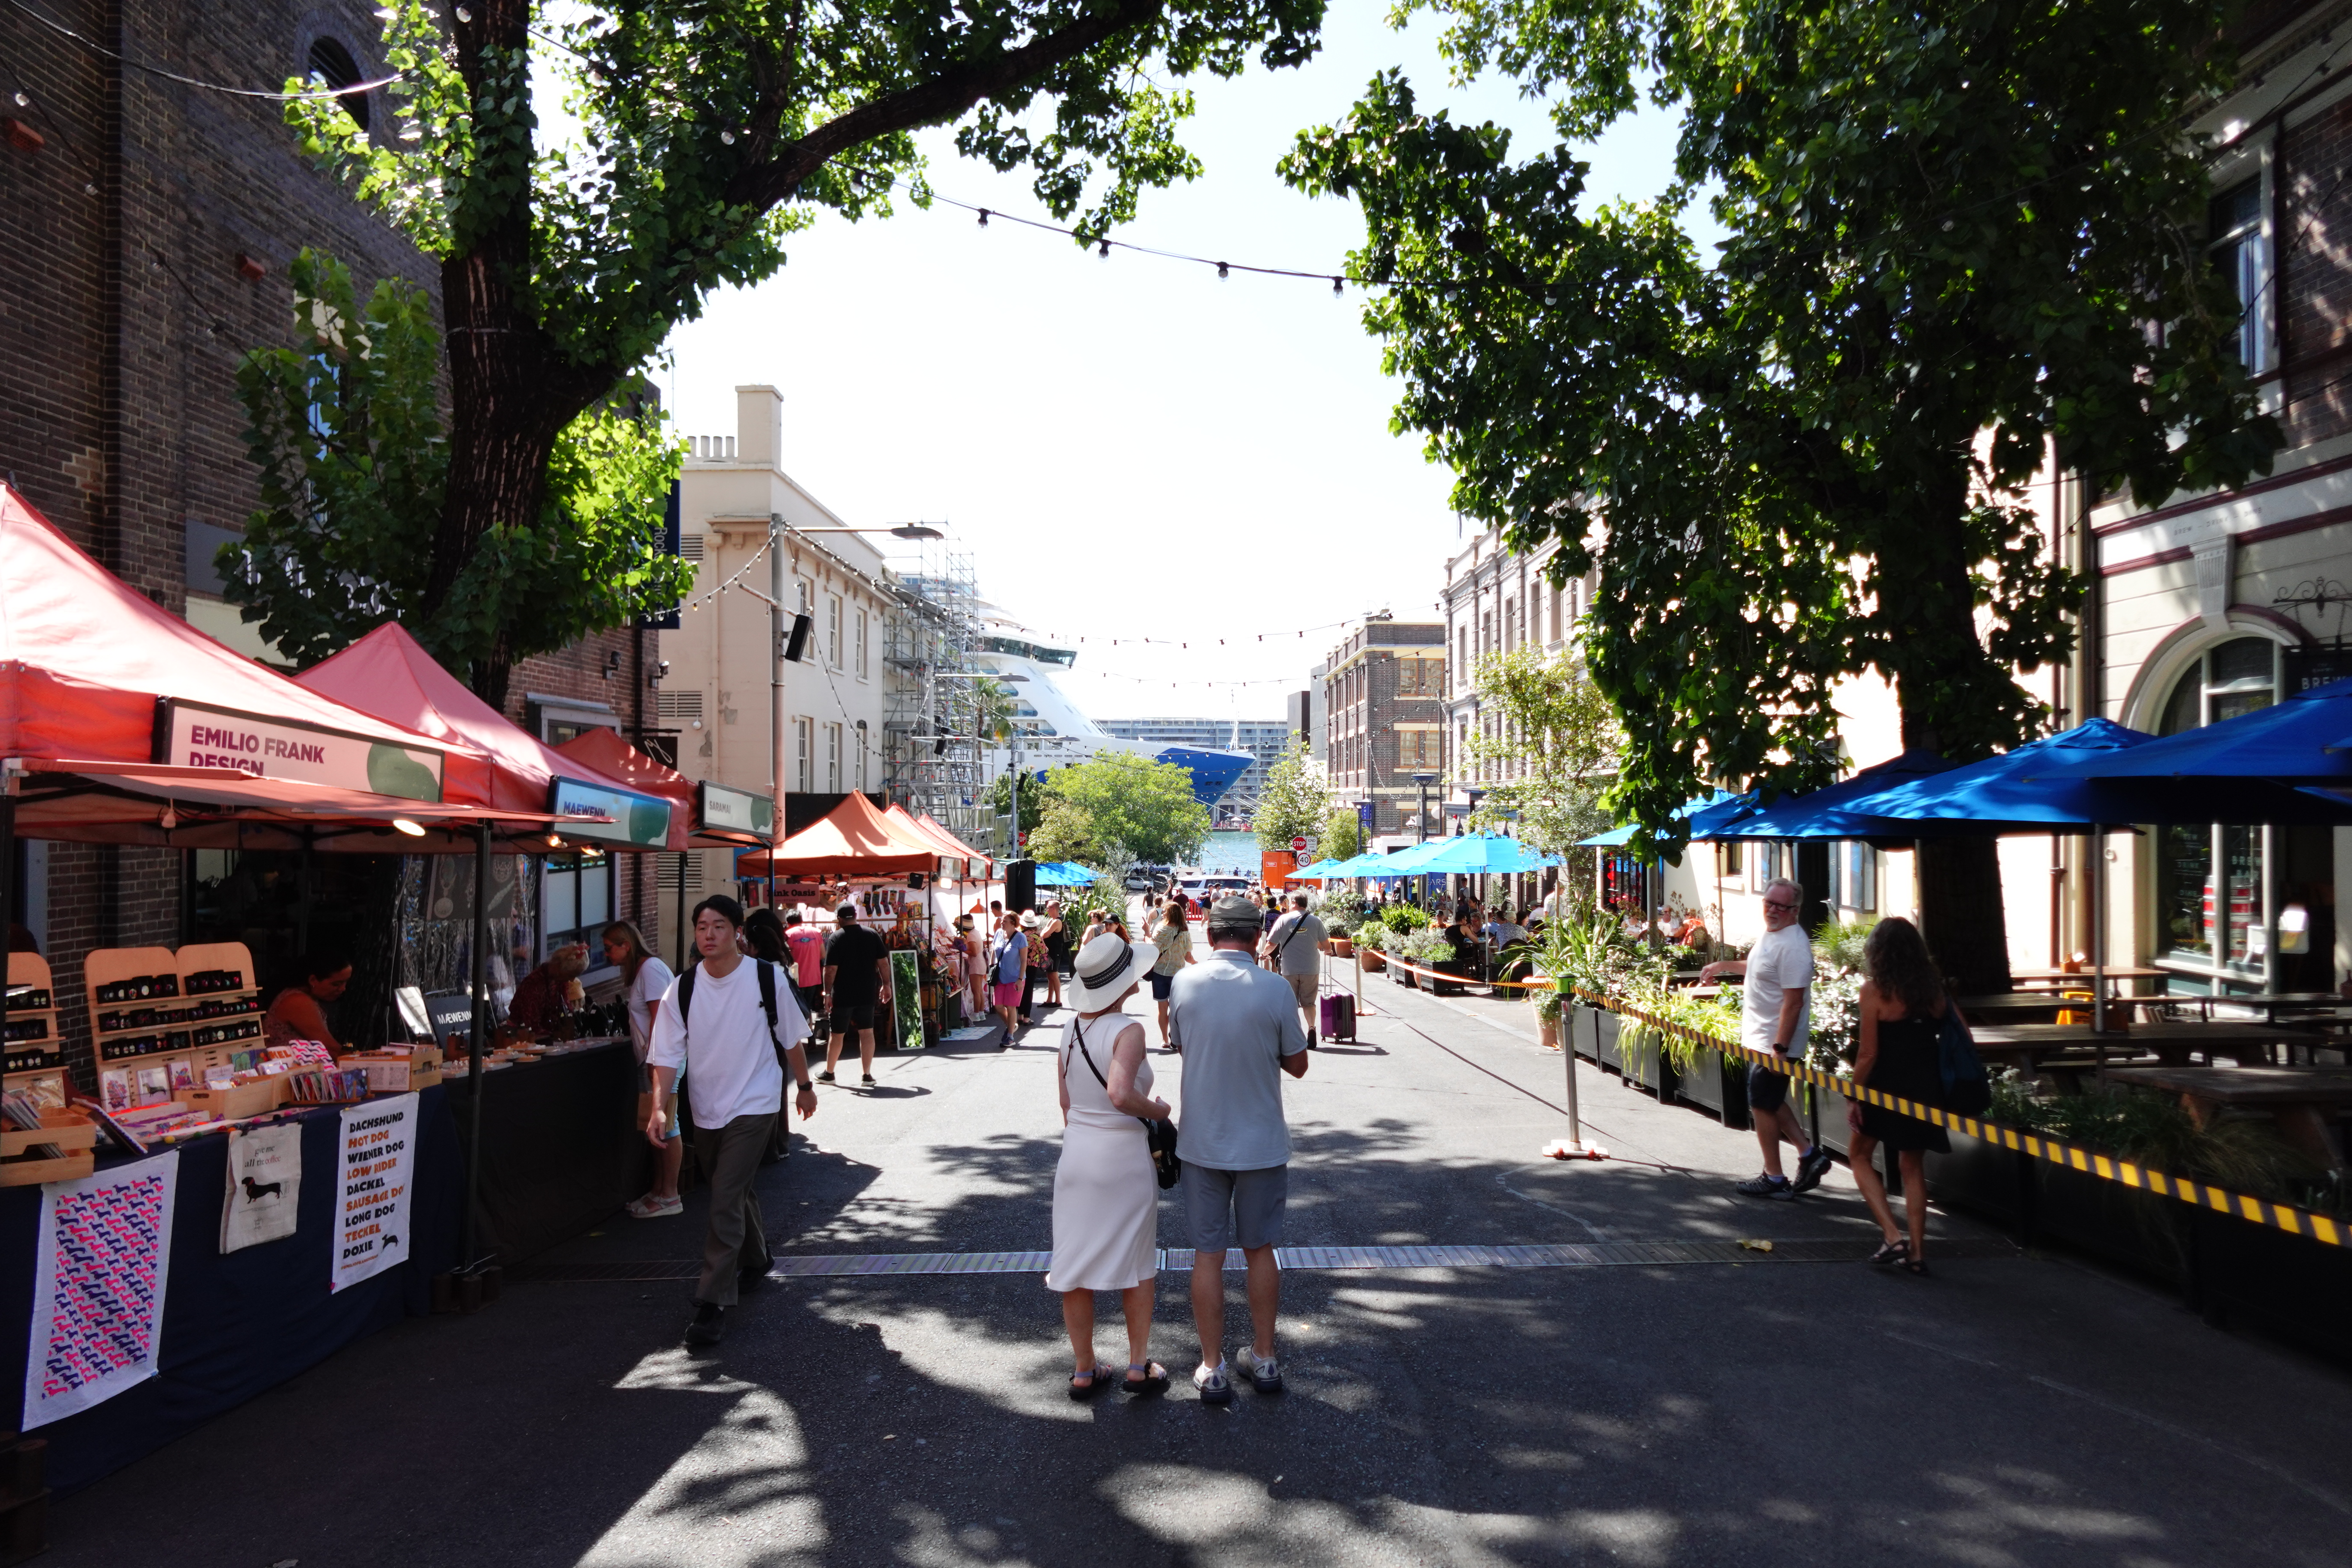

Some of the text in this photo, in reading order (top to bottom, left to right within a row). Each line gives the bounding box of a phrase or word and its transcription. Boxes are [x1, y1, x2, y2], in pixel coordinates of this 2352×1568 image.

[191, 725, 325, 764] EMILIO FRANK
[190, 751, 264, 776] DESIGN
[563, 801, 605, 817] MAEWENN
[709, 800, 731, 814] SARAMAI
[349, 1112, 404, 1133] DACHSHUND
[348, 1130, 389, 1149] HOT DOG
[245, 1159, 255, 1167] all
[265, 1155, 281, 1164] coffee
[254, 1148, 265, 1157] give
[348, 1140, 404, 1164] WIENER DOG
[347, 1158, 397, 1181] LOW RIDER
[347, 1177, 385, 1196] DACKEL
[346, 1184, 405, 1212] SAUSAGE DO
[345, 1203, 395, 1228] LONG DOG
[345, 1223, 381, 1243] TECKEL
[343, 1240, 373, 1259] DOXIE
